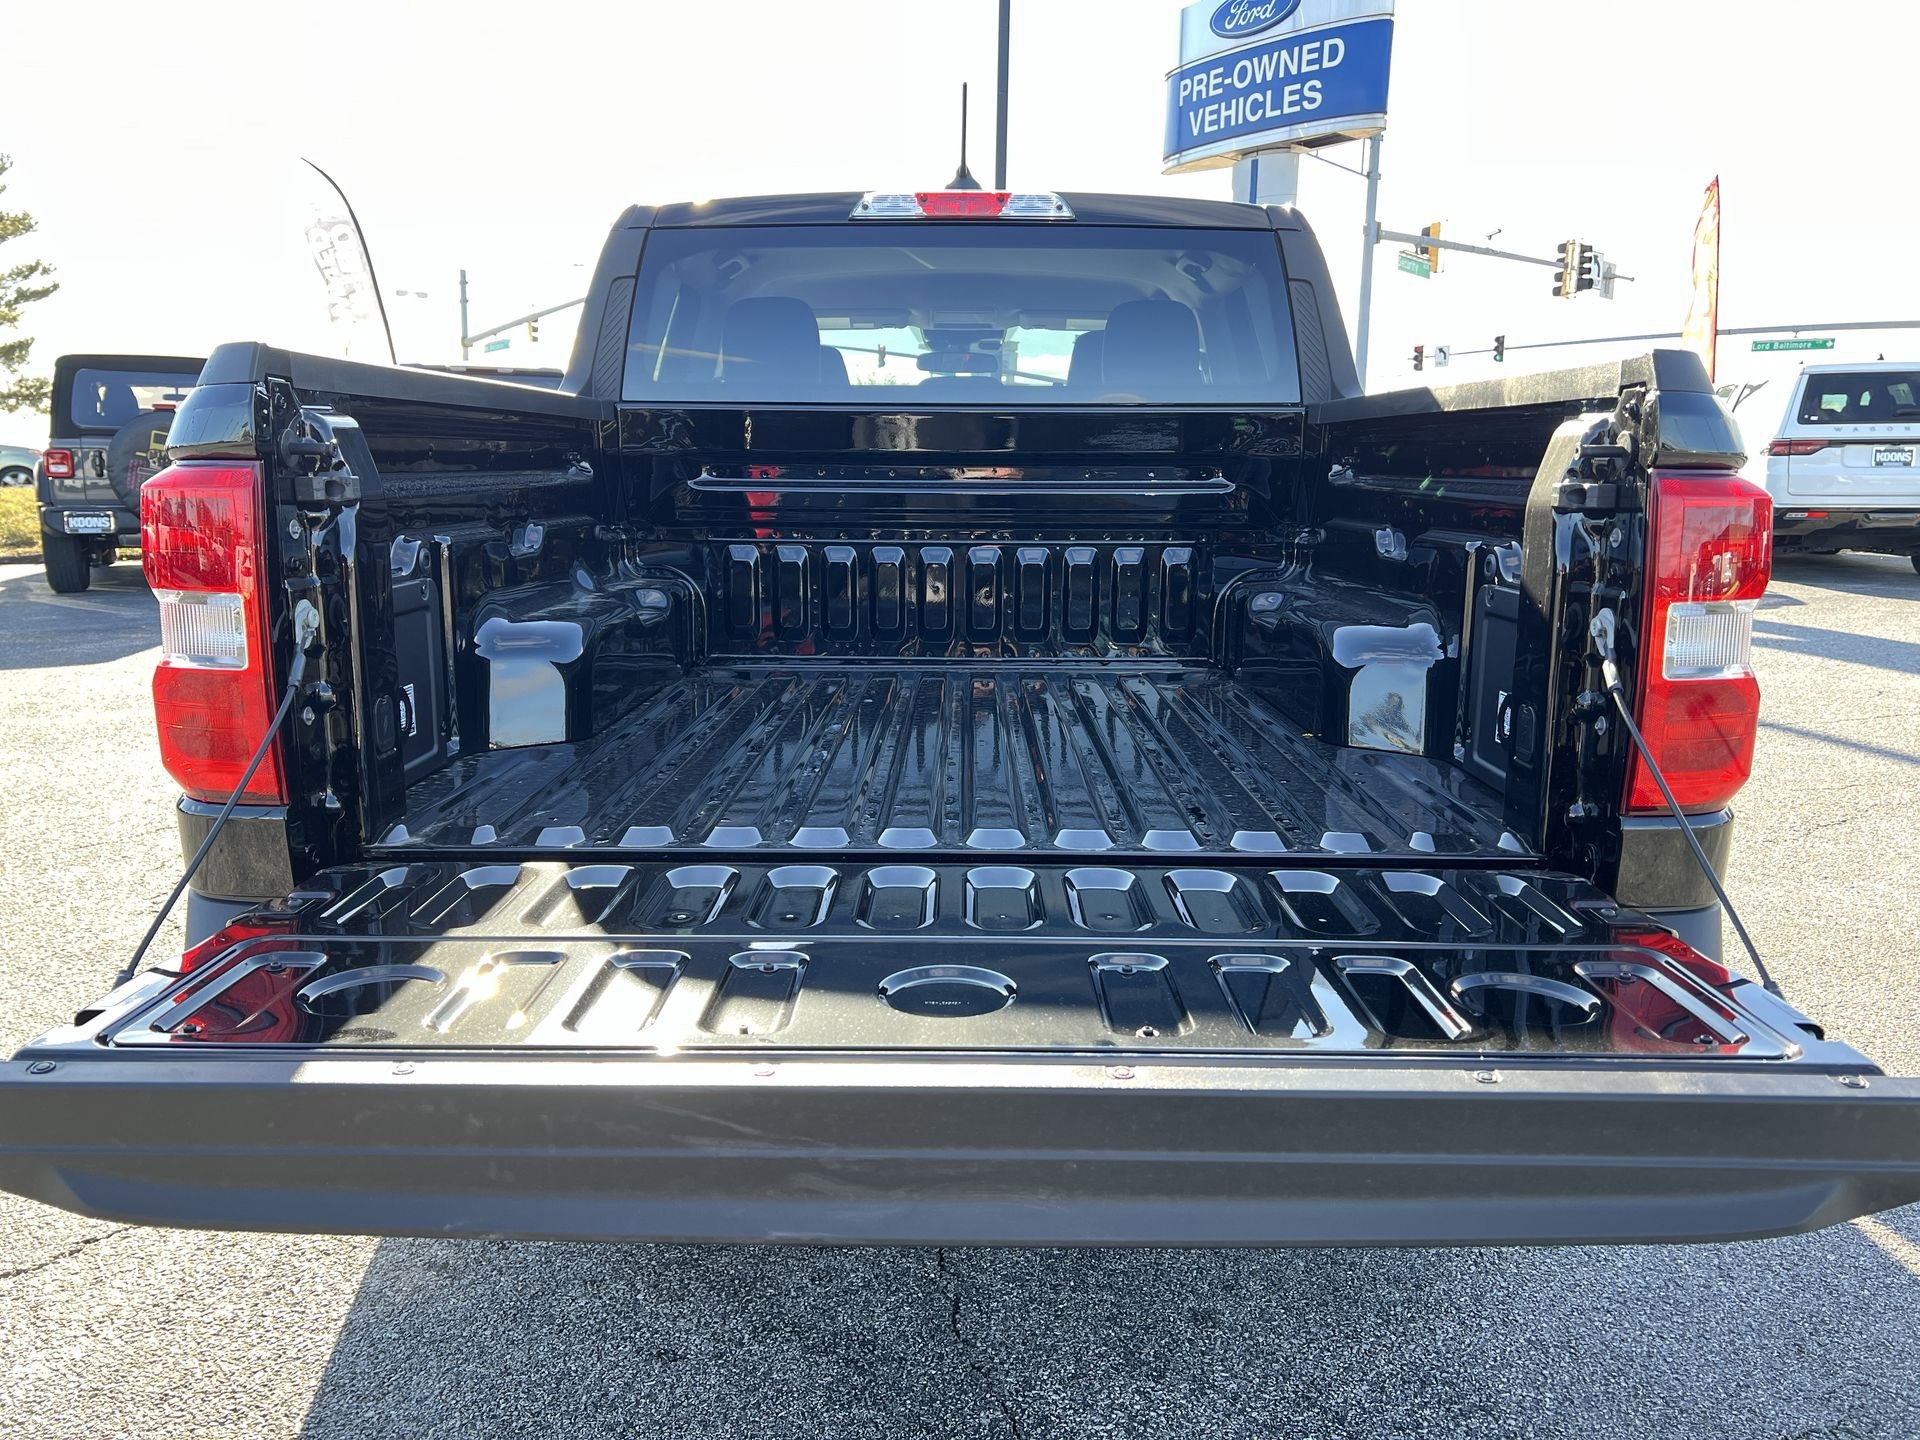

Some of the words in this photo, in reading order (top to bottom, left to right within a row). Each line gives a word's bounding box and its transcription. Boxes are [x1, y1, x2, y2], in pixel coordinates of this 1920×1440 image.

[1225, 0, 1276, 30] Ford
[1179, 37, 1345, 107] PRE-OWNED
[1189, 80, 1323, 137] VEHICLES
[1752, 341, 1770, 350] Lord
[1773, 341, 1812, 350] Baltimore
[1875, 452, 1912, 462] KOONS
[68, 516, 110, 528] KOONS
